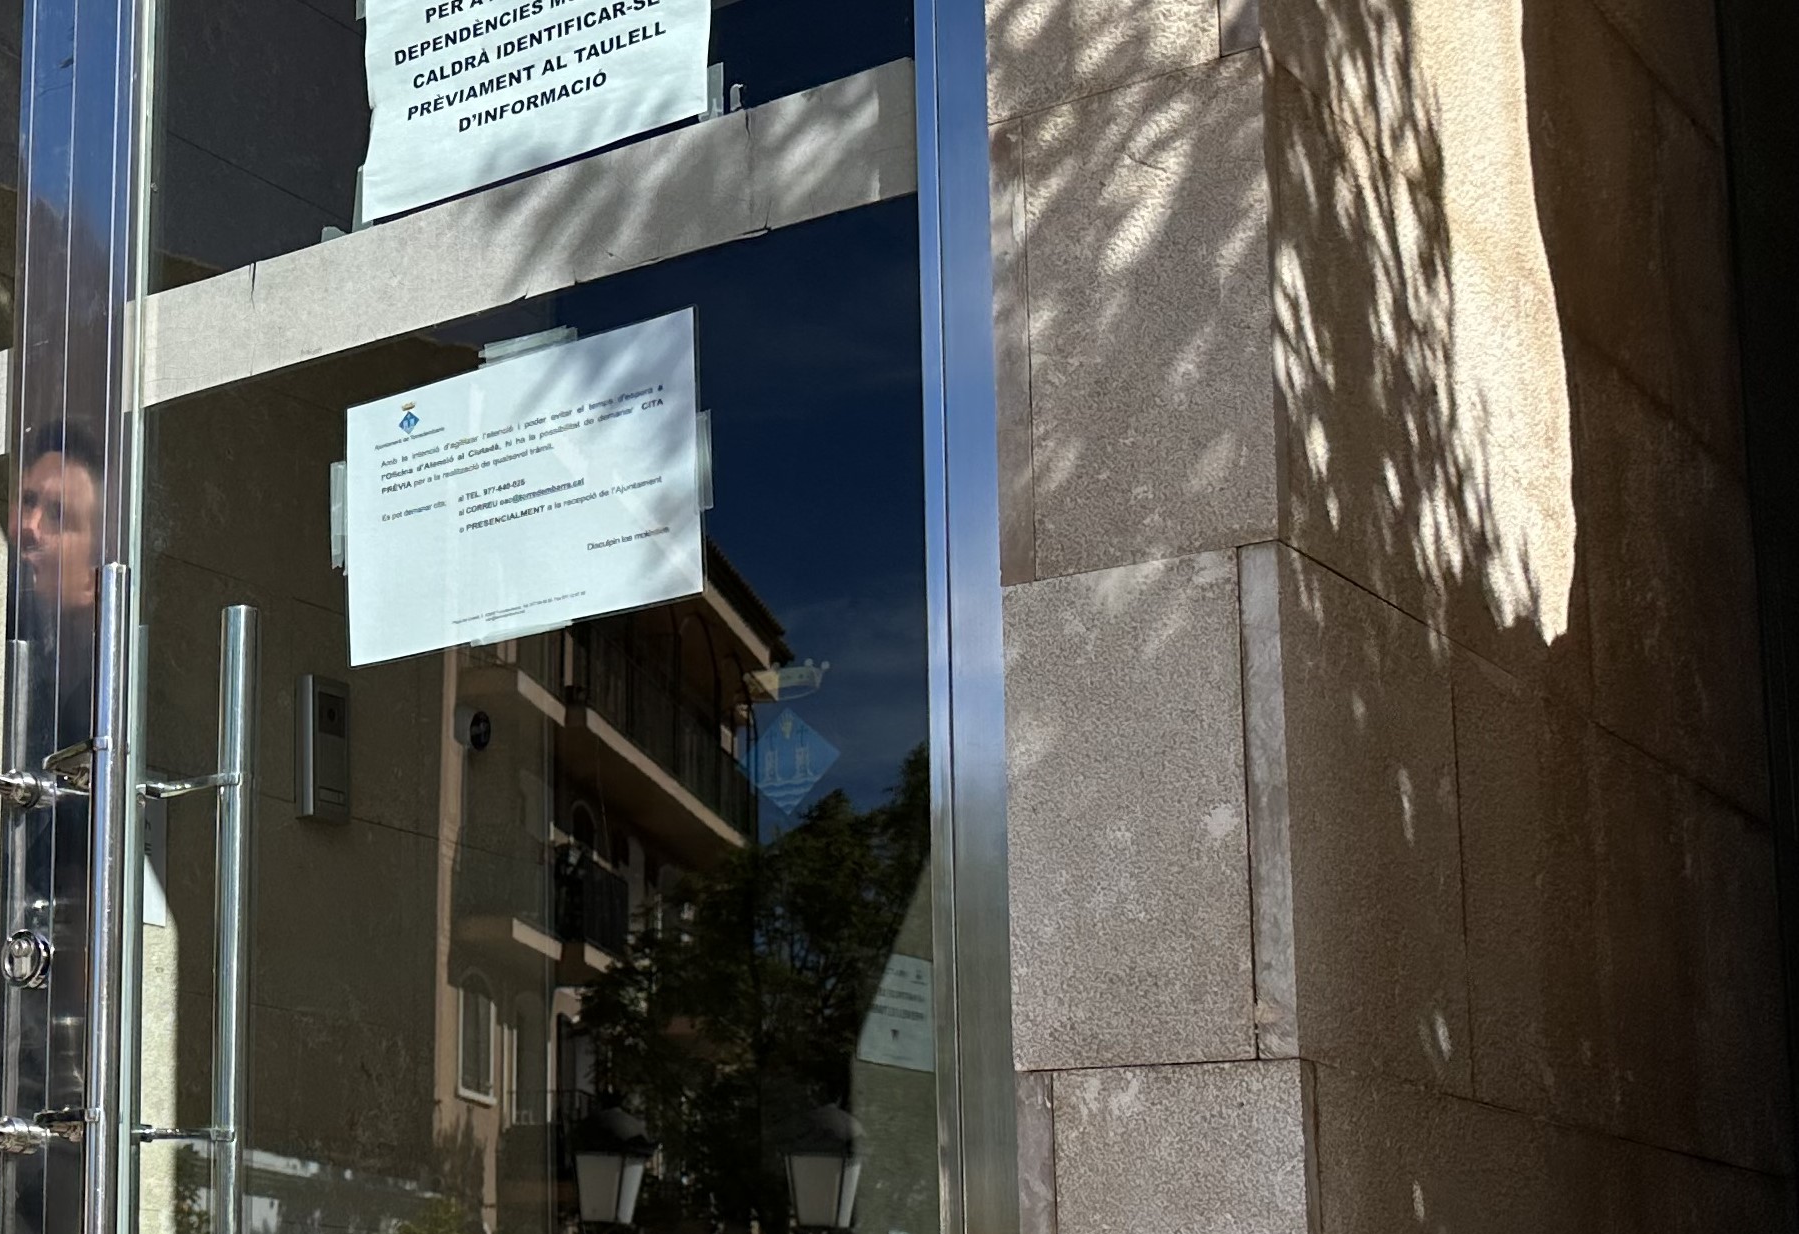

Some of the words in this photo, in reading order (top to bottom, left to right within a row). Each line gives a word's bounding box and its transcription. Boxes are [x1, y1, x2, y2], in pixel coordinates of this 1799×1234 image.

[425, 0, 463, 23] PER
[394, 0, 543, 65] DEPENDÈNCIES
[407, 64, 535, 121] PRÈVIAMENT
[541, 57, 568, 76] AL
[573, 21, 667, 63] TAULELL
[413, 48, 490, 89] CALDRÀ
[641, 398, 664, 410] CITA
[466, 500, 498, 514] CORREU
[466, 505, 545, 532] PRESENCIALMENT
